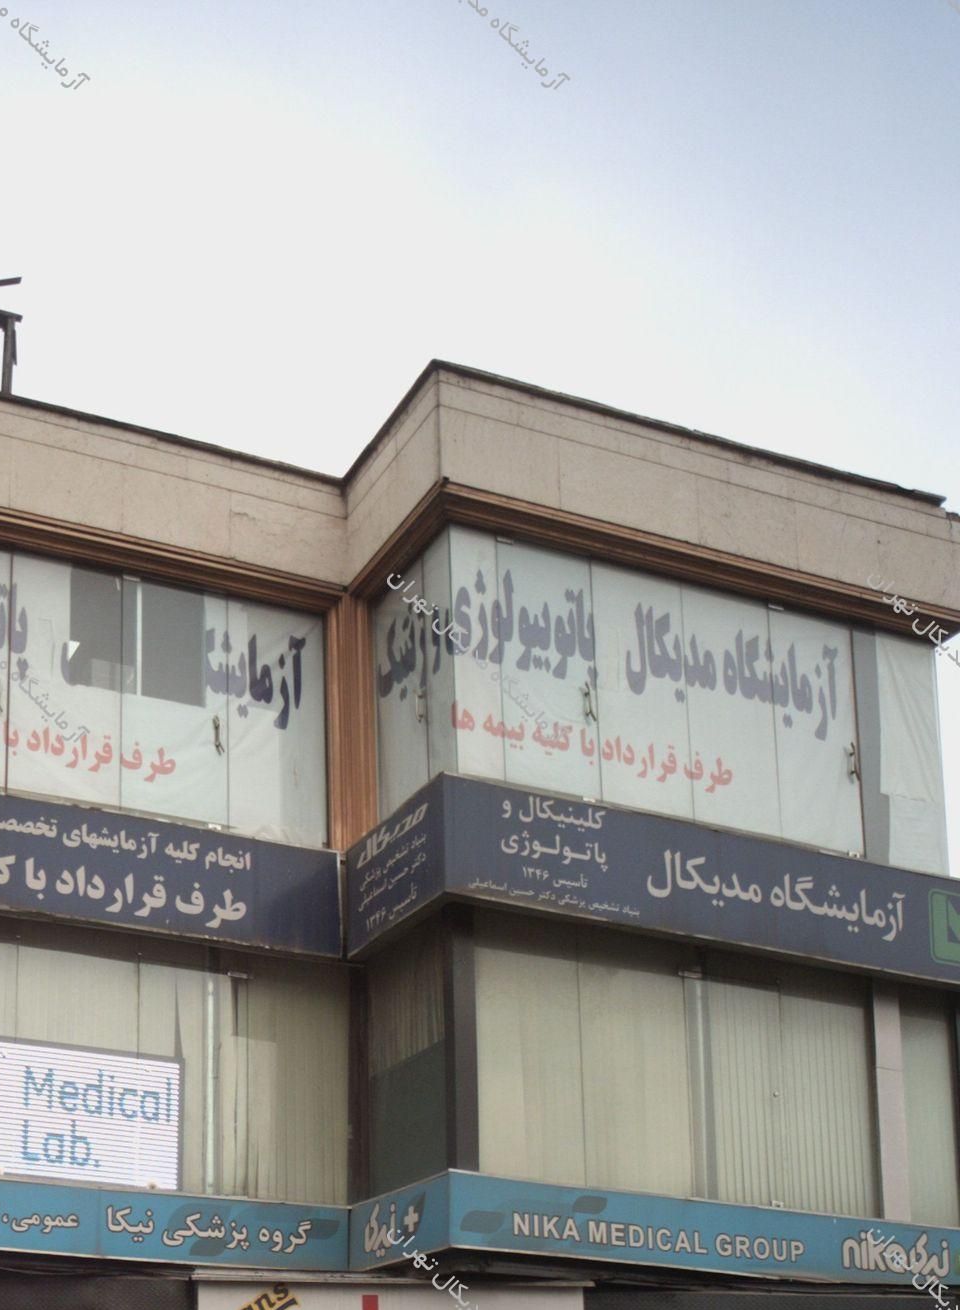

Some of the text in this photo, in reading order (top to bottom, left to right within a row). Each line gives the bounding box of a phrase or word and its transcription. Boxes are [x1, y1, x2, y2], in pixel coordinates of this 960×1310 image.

[205, 627, 307, 731] آزمایش
[625, 601, 839, 742] آزمایشگاه مدیکال
[4, 717, 19, 757] با
[450, 700, 476, 733] ها
[482, 711, 526, 751] بیمه
[26, 721, 113, 774] قرارداد
[120, 740, 176, 783] طرف
[580, 727, 596, 766] با
[602, 735, 677, 783] قرارداد
[684, 754, 734, 794] طرف
[356, 802, 429, 870] مدیکال
[501, 795, 606, 832] کلینیکال و
[62, 822, 160, 860] آزمایشهای
[164, 840, 201, 864] کلیه
[204, 845, 252, 874] انجام
[24, 856, 47, 901] با
[55, 864, 168, 918] قرارداد
[521, 866, 551, 881] ۱۳۴۶
[645, 848, 906, 942] آزمایشگاه مدیکال
[175, 881, 248, 929] طرف
[23, 1062, 174, 1125] Medical
[21, 1118, 102, 1169] Lab.
[105, 1205, 312, 1254] گروه پزشکی نیکا
[512, 1210, 806, 1264] NIKA MEDICAL GROUP
[842, 1229, 908, 1274] nika
